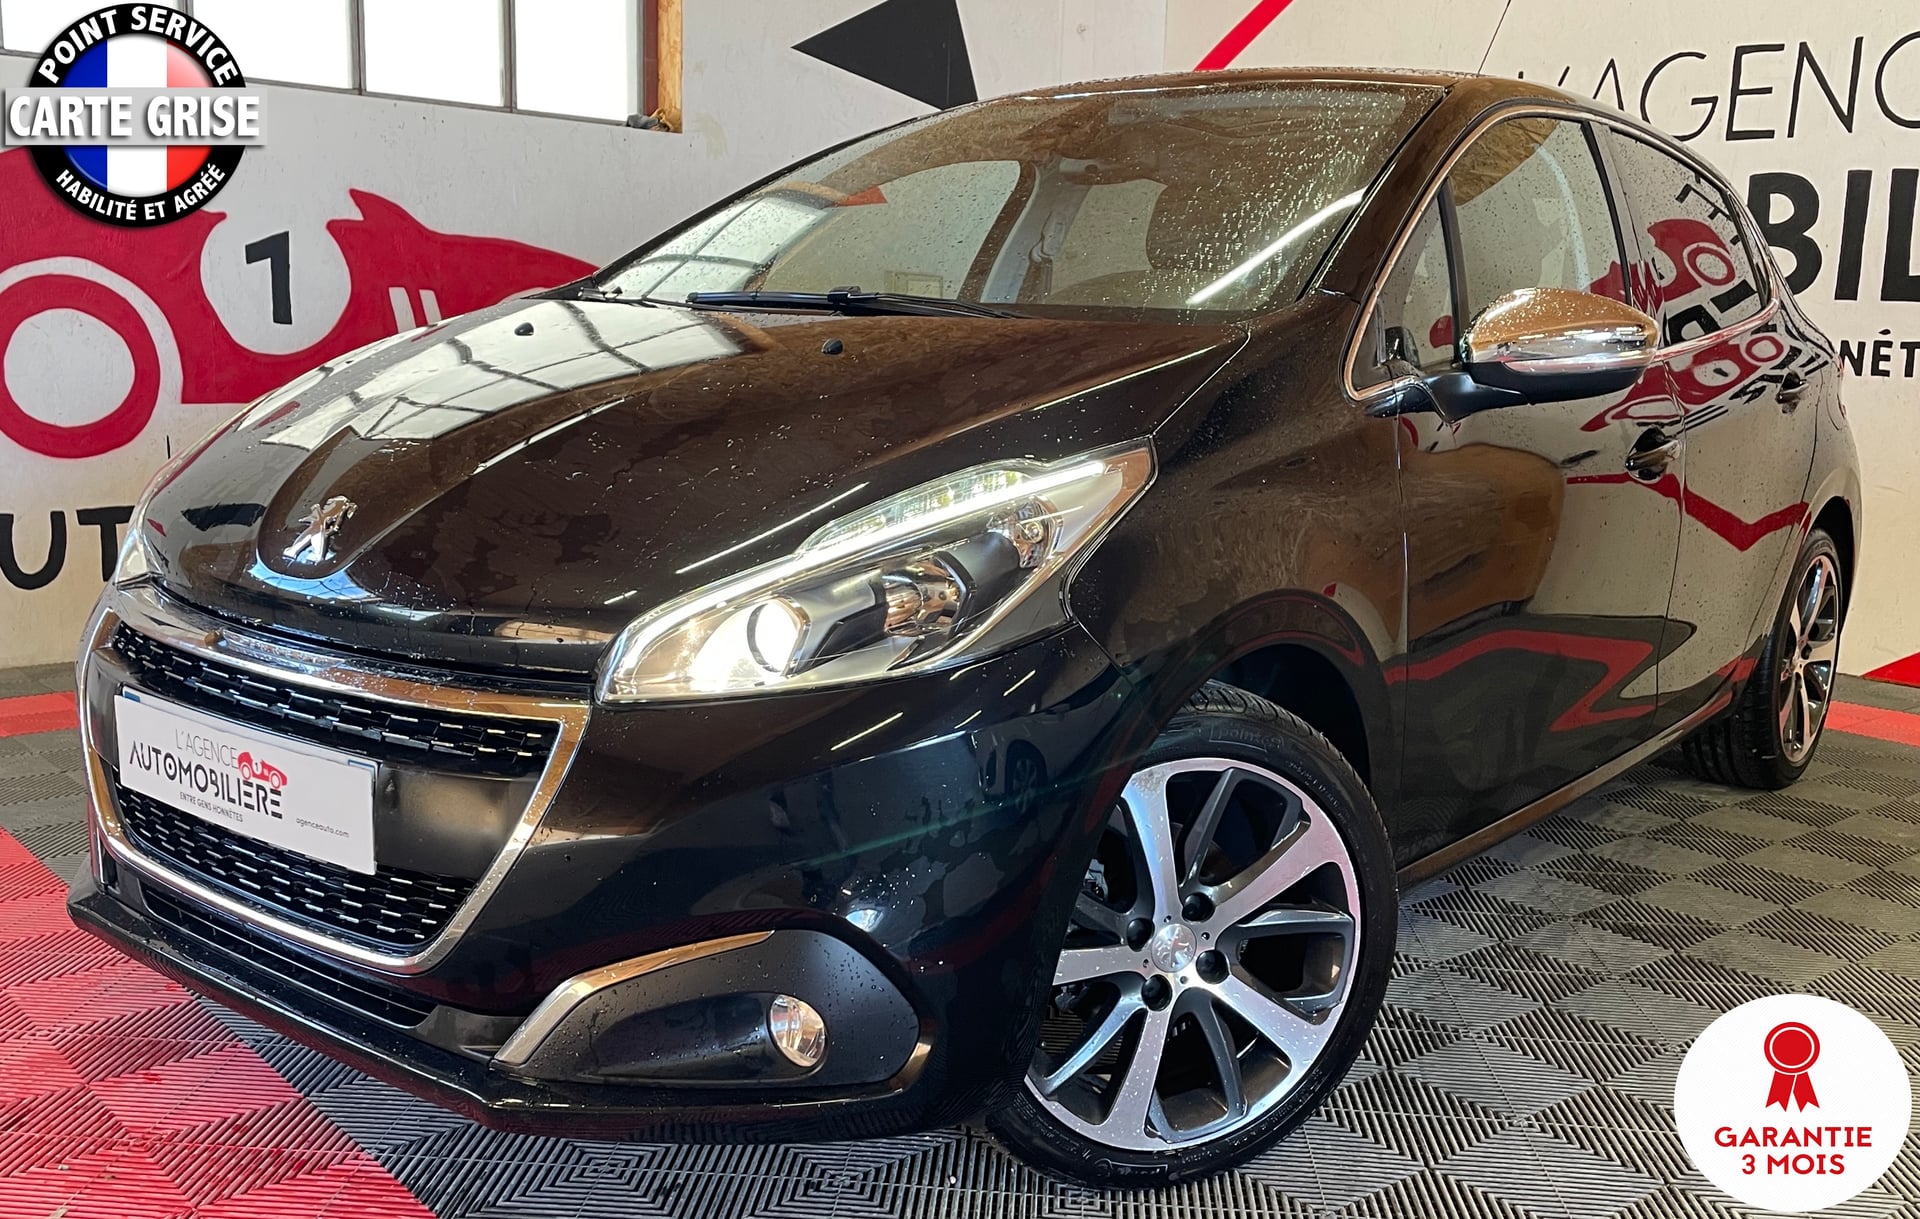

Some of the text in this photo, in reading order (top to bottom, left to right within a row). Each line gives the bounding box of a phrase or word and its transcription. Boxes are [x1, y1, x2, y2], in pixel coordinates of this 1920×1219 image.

[245, 231, 292, 324] 1
[175, 728, 239, 770] L'AGENCE
[180, 791, 196, 805] ENTRE
[197, 798, 212, 812] GENS
[296, 817, 350, 838] agenceauto.com
